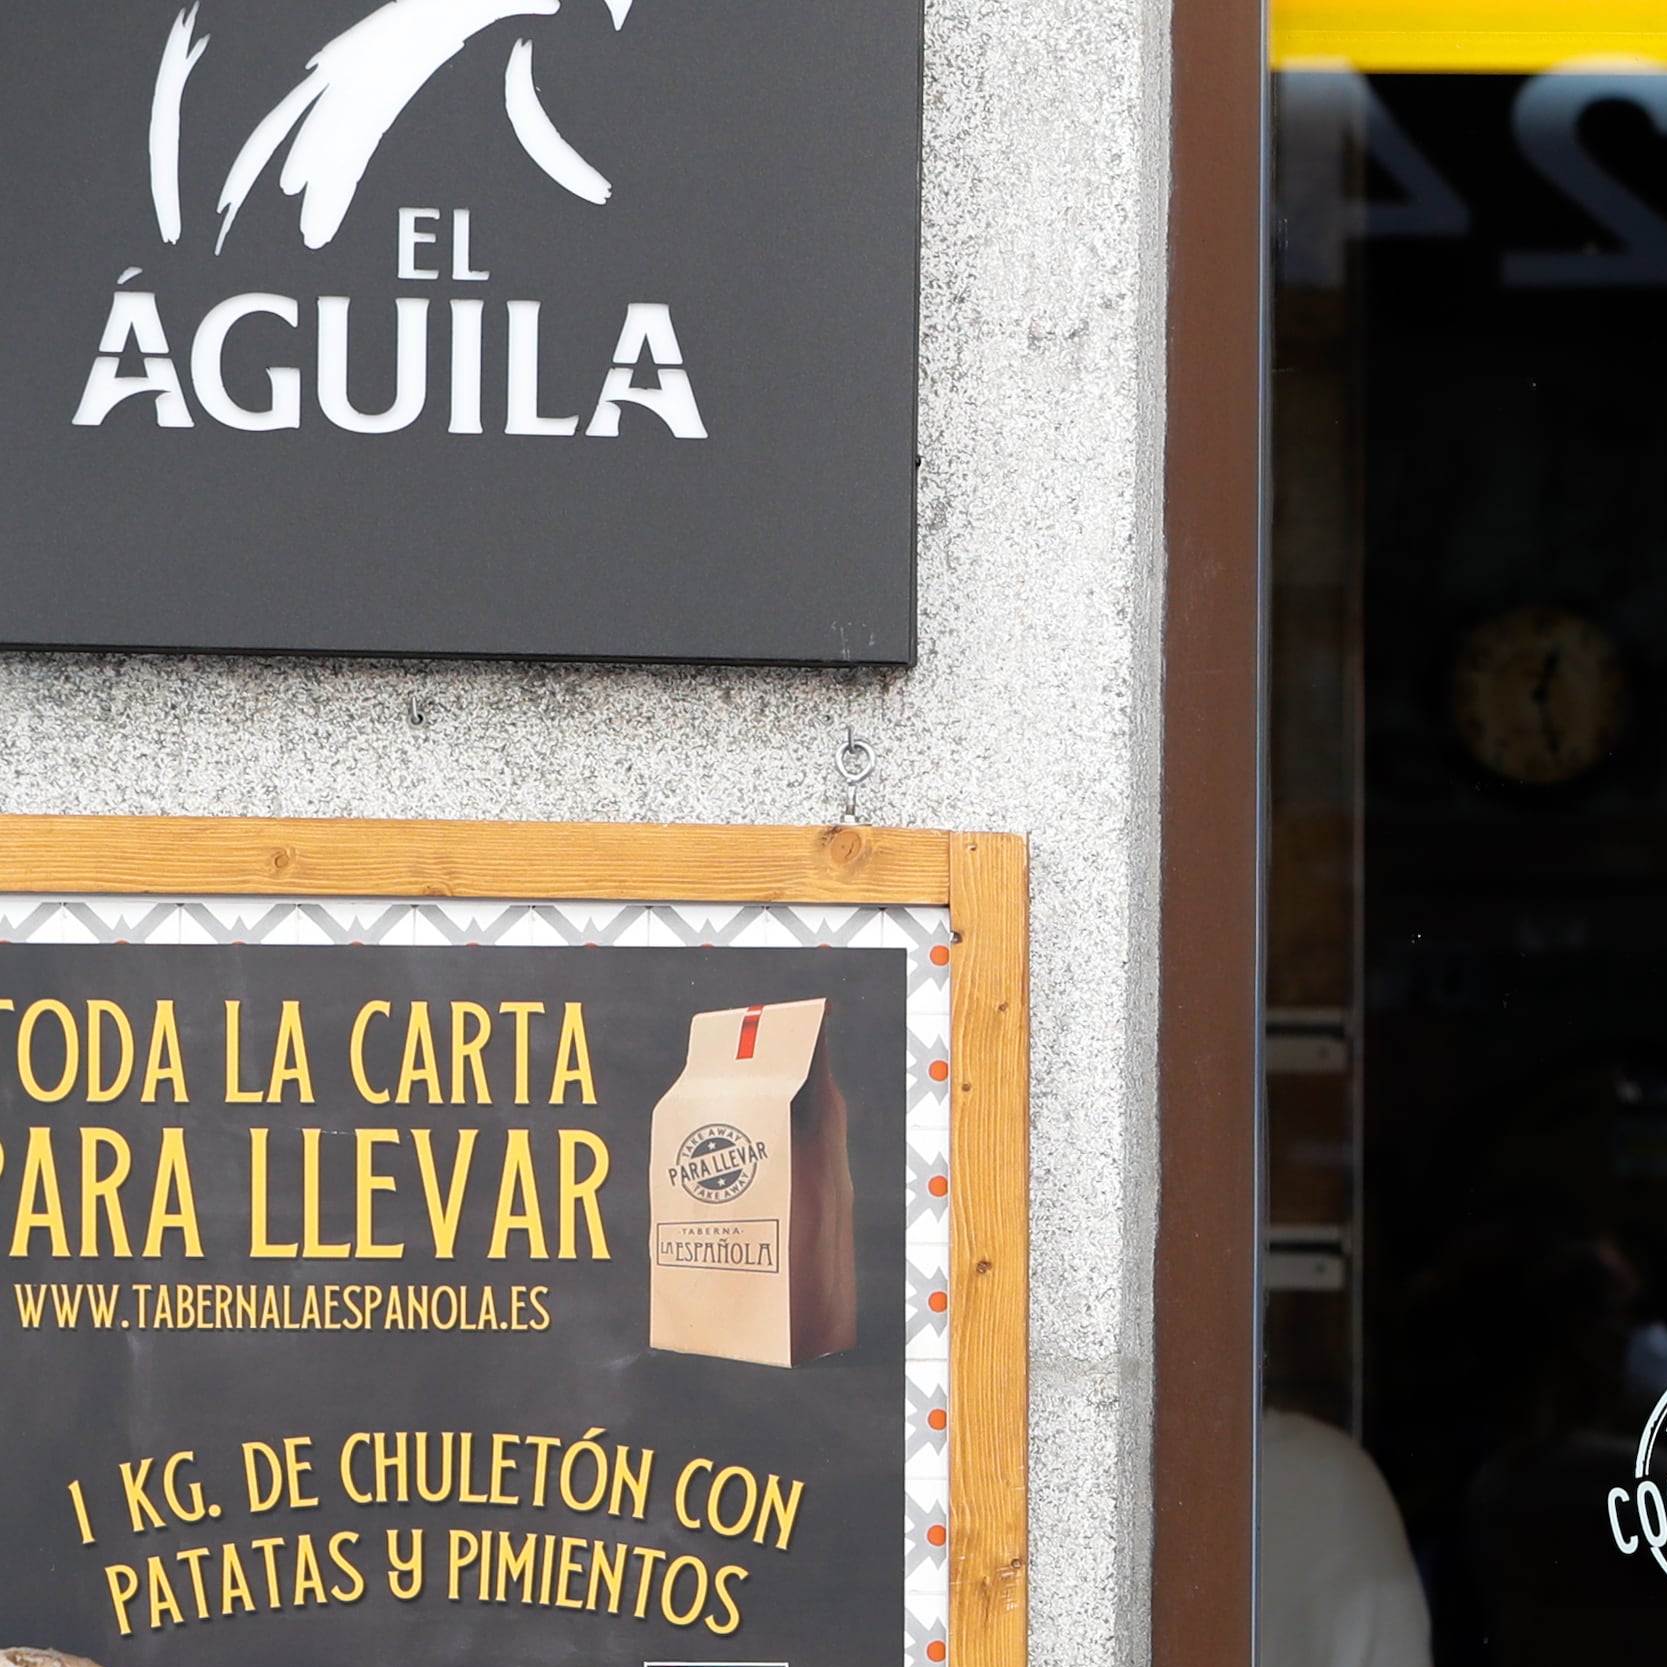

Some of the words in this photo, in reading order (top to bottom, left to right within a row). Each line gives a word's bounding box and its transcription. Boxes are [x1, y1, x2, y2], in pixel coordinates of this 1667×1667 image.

[398, 207, 490, 281] EL
[72, 267, 708, 439] ÁGUILA
[0, 999, 189, 1104] ODA
[225, 1000, 316, 1104] LA
[350, 1001, 598, 1105] CARTA
[668, 1161, 710, 1187] PARA
[712, 1141, 768, 1176] LLEVAR
[681, 1129, 705, 1159] TAKE
[708, 1128, 742, 1143] AWAY
[0, 1128, 204, 1258] ARA
[249, 1128, 612, 1260] LLEVAR
[693, 1184, 721, 1201] TAKE
[722, 1171, 750, 1200] AWAY
[660, 1241, 673, 1255] LA
[676, 1239, 773, 1266] ESPAÑOLA
[15, 1283, 550, 1331] WWW.TABERNALAESPANOLA.ES
[119, 1450, 222, 1533] KG.
[243, 1436, 318, 1514] DE
[340, 1427, 655, 1521] CHULETÓN
[674, 1458, 805, 1552] CON
[105, 1531, 365, 1636] PATATAS
[449, 1531, 749, 1636] PIMIENTOS
